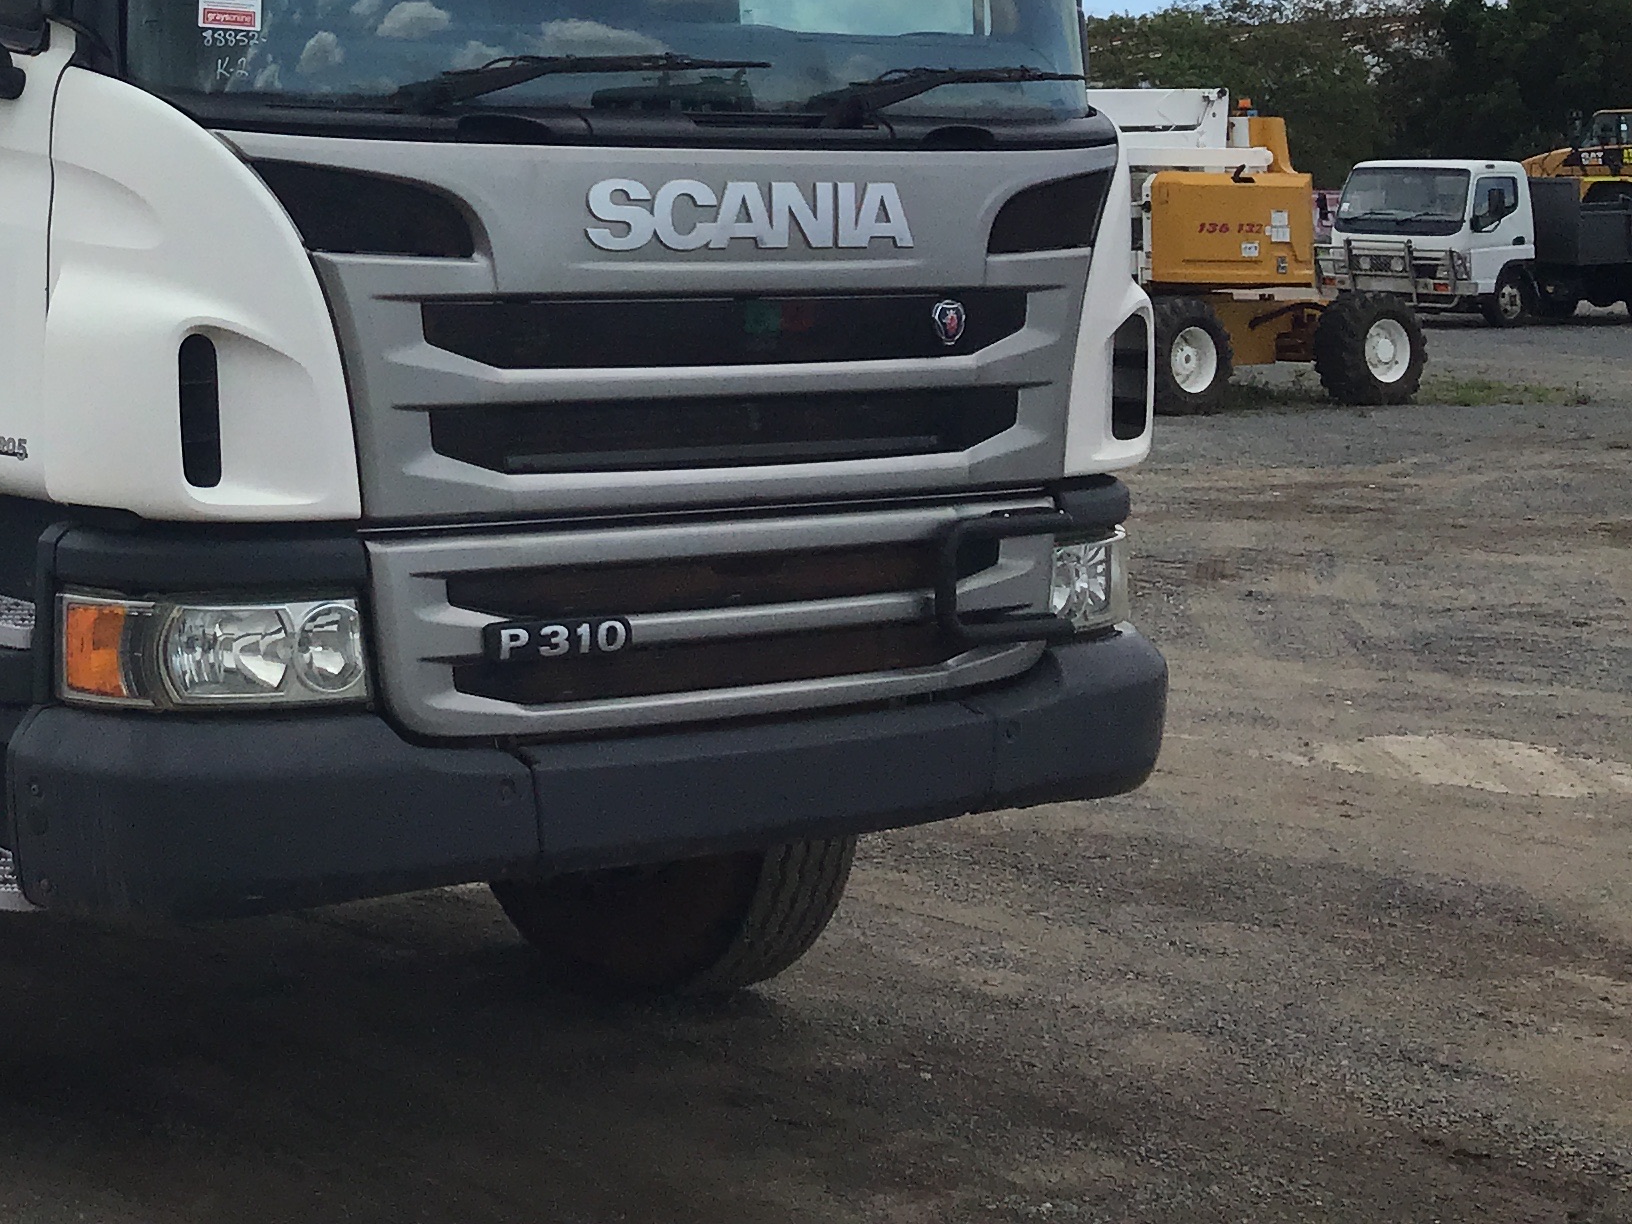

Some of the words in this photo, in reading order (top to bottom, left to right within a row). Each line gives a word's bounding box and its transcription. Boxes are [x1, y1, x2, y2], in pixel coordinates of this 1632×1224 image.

[1580, 151, 1604, 165] CAT
[583, 178, 914, 251] SCANIA
[499, 628, 530, 660] P
[539, 620, 627, 658] 310
